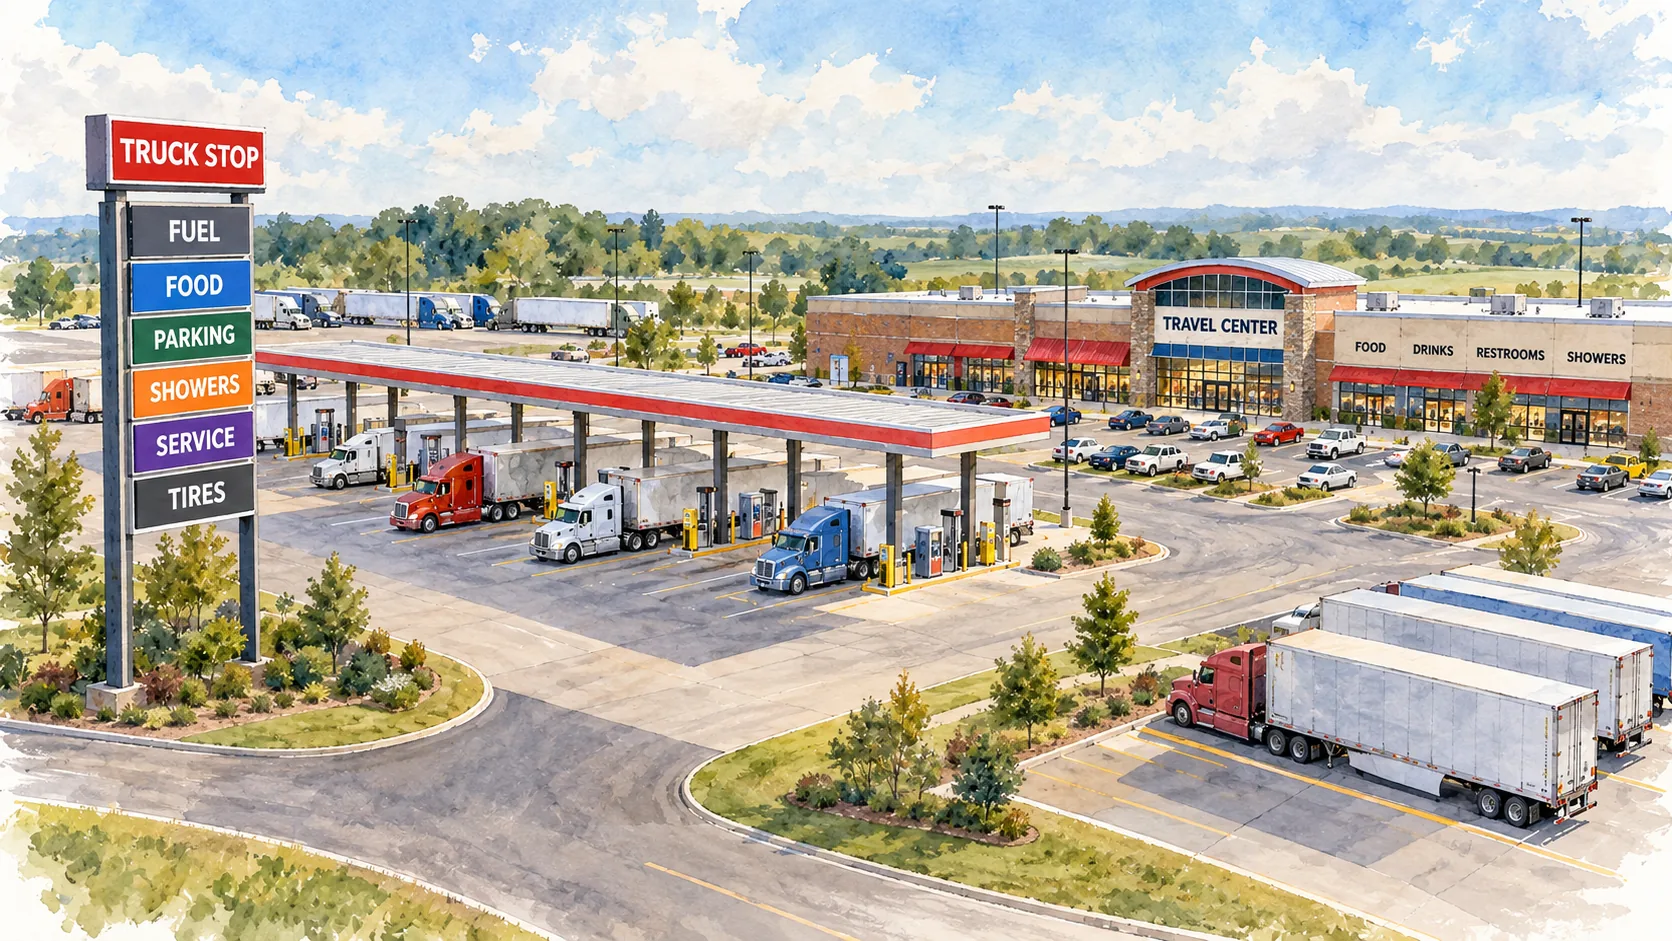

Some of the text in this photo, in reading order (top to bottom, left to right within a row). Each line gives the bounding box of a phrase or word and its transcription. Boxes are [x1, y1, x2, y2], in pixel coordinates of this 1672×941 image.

[120, 138, 259, 169] TRUCK STOP
[169, 220, 220, 242] FUEL
[166, 274, 223, 297] FOOD
[154, 324, 235, 350] PARKING
[1163, 316, 1278, 335] TRAVEL CENTER
[1355, 341, 1626, 365] FOOD DRINKS RESTROOMS SHOWERS
[150, 374, 240, 402] SHOWERS
[156, 426, 235, 457] SERVICE
[168, 481, 226, 510] TIRES
